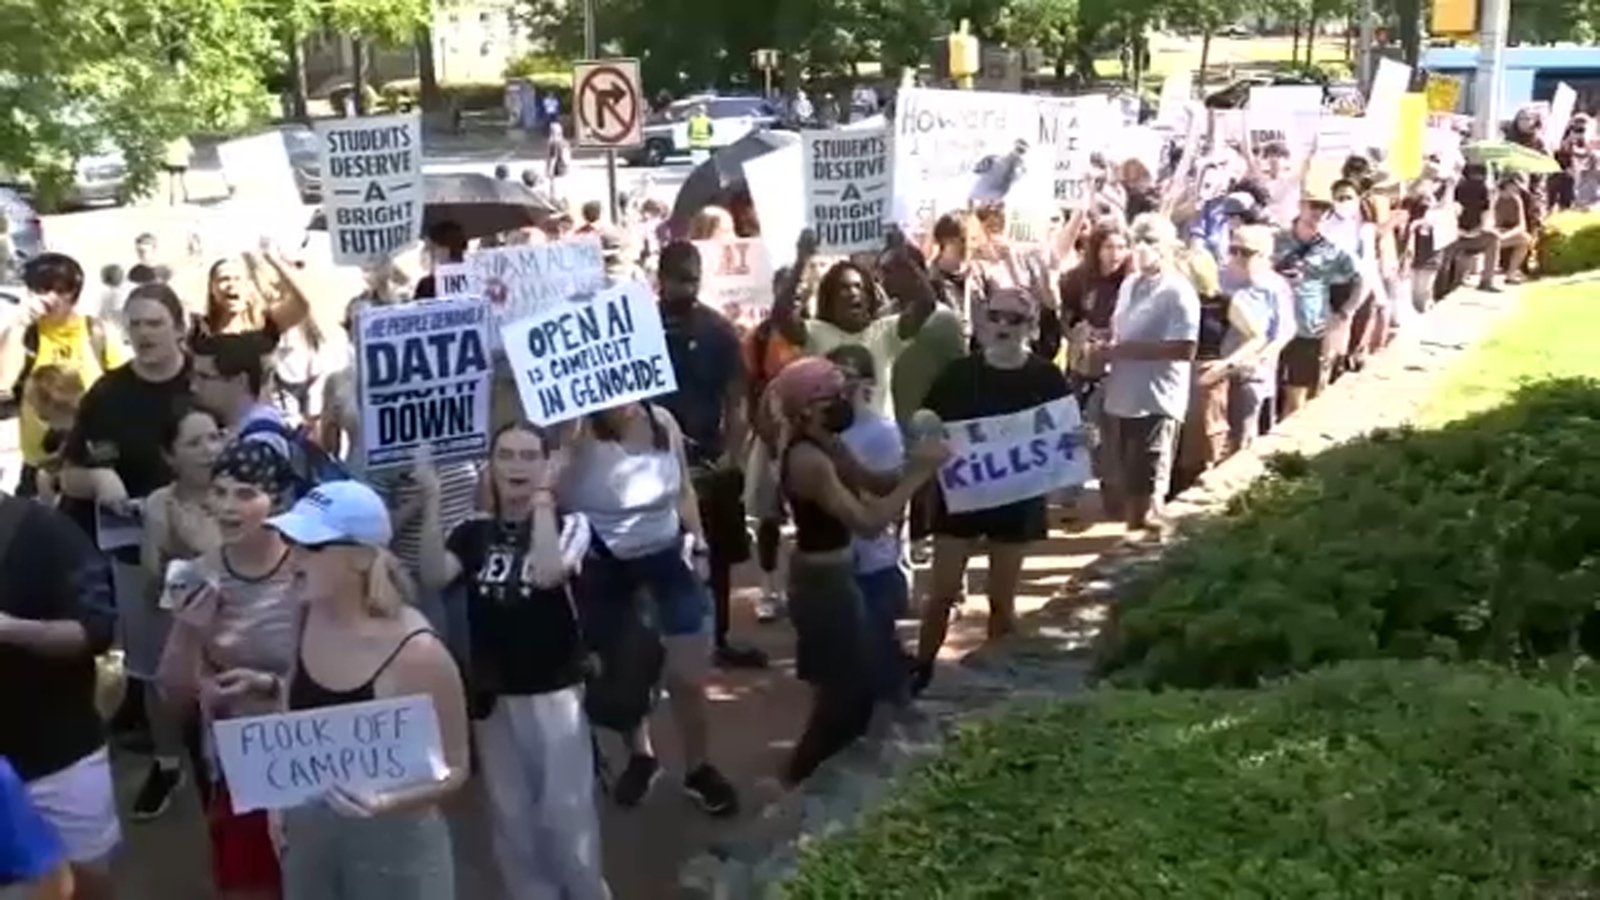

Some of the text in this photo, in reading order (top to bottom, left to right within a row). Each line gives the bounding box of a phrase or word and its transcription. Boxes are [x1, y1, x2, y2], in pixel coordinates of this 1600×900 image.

[326, 124, 411, 153] STUDENTS
[812, 136, 886, 159] STUDENTS
[329, 151, 411, 178] DESERVE
[813, 156, 886, 180] DESERVE
[364, 180, 387, 202] A
[841, 182, 861, 201] A
[336, 201, 413, 226] BRIGHT
[814, 198, 884, 221] BRIGHT
[528, 294, 634, 358] OPEN AI
[366, 329, 488, 389] DATA
[526, 336, 632, 385] IS COMPLICIT
[537, 354, 666, 418] IN GENOCIDE
[378, 394, 474, 446] DOWN!
[241, 706, 412, 756] FLOCK OFF
[265, 747, 406, 791] CAMPUS
